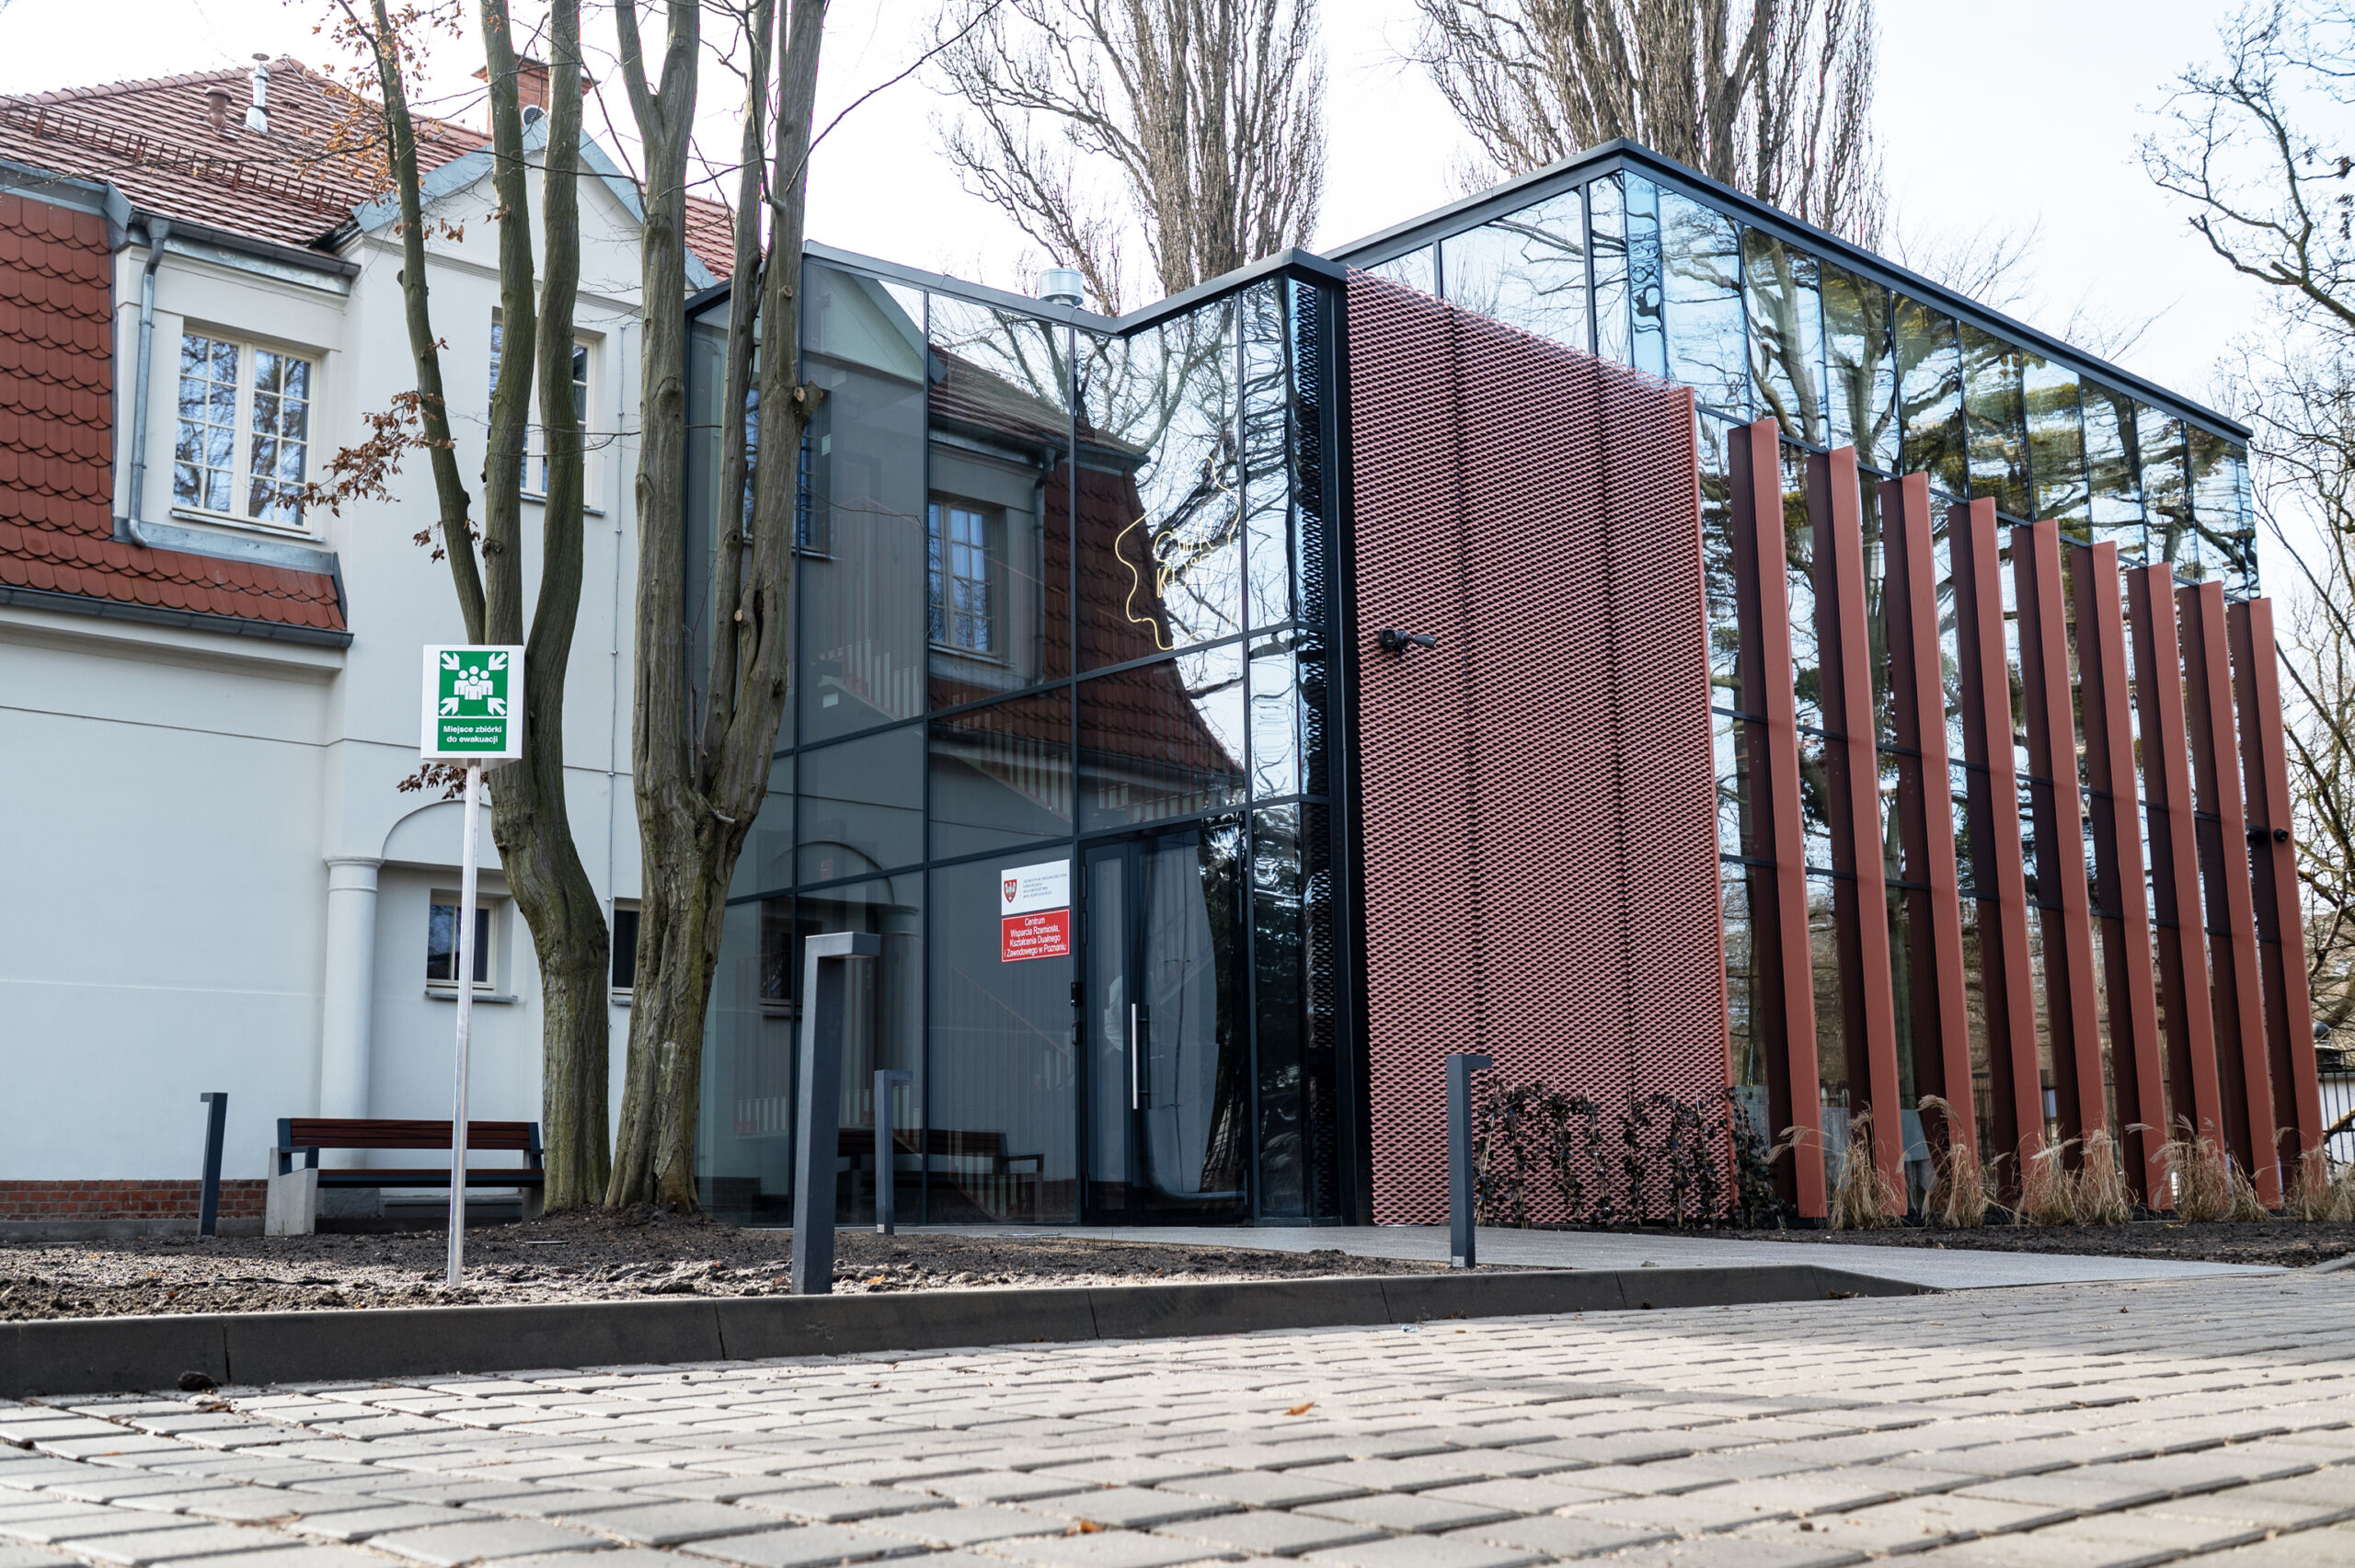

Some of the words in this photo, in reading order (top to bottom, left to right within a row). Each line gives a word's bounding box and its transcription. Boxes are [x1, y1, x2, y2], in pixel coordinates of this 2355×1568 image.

[443, 726, 474, 734] Miejsce
[459, 736, 498, 744] ewakuacji
[1024, 917, 1045, 926] Centrum
[1010, 928, 1032, 937] Wsparcia
[1033, 923, 1060, 934] Rzemiosła,
[1009, 937, 1037, 947] Kształcenia
[1037, 934, 1061, 944] Dualnego
[1006, 947, 1038, 957] Zawodowego
[1043, 942, 1067, 953] Poznaniu
